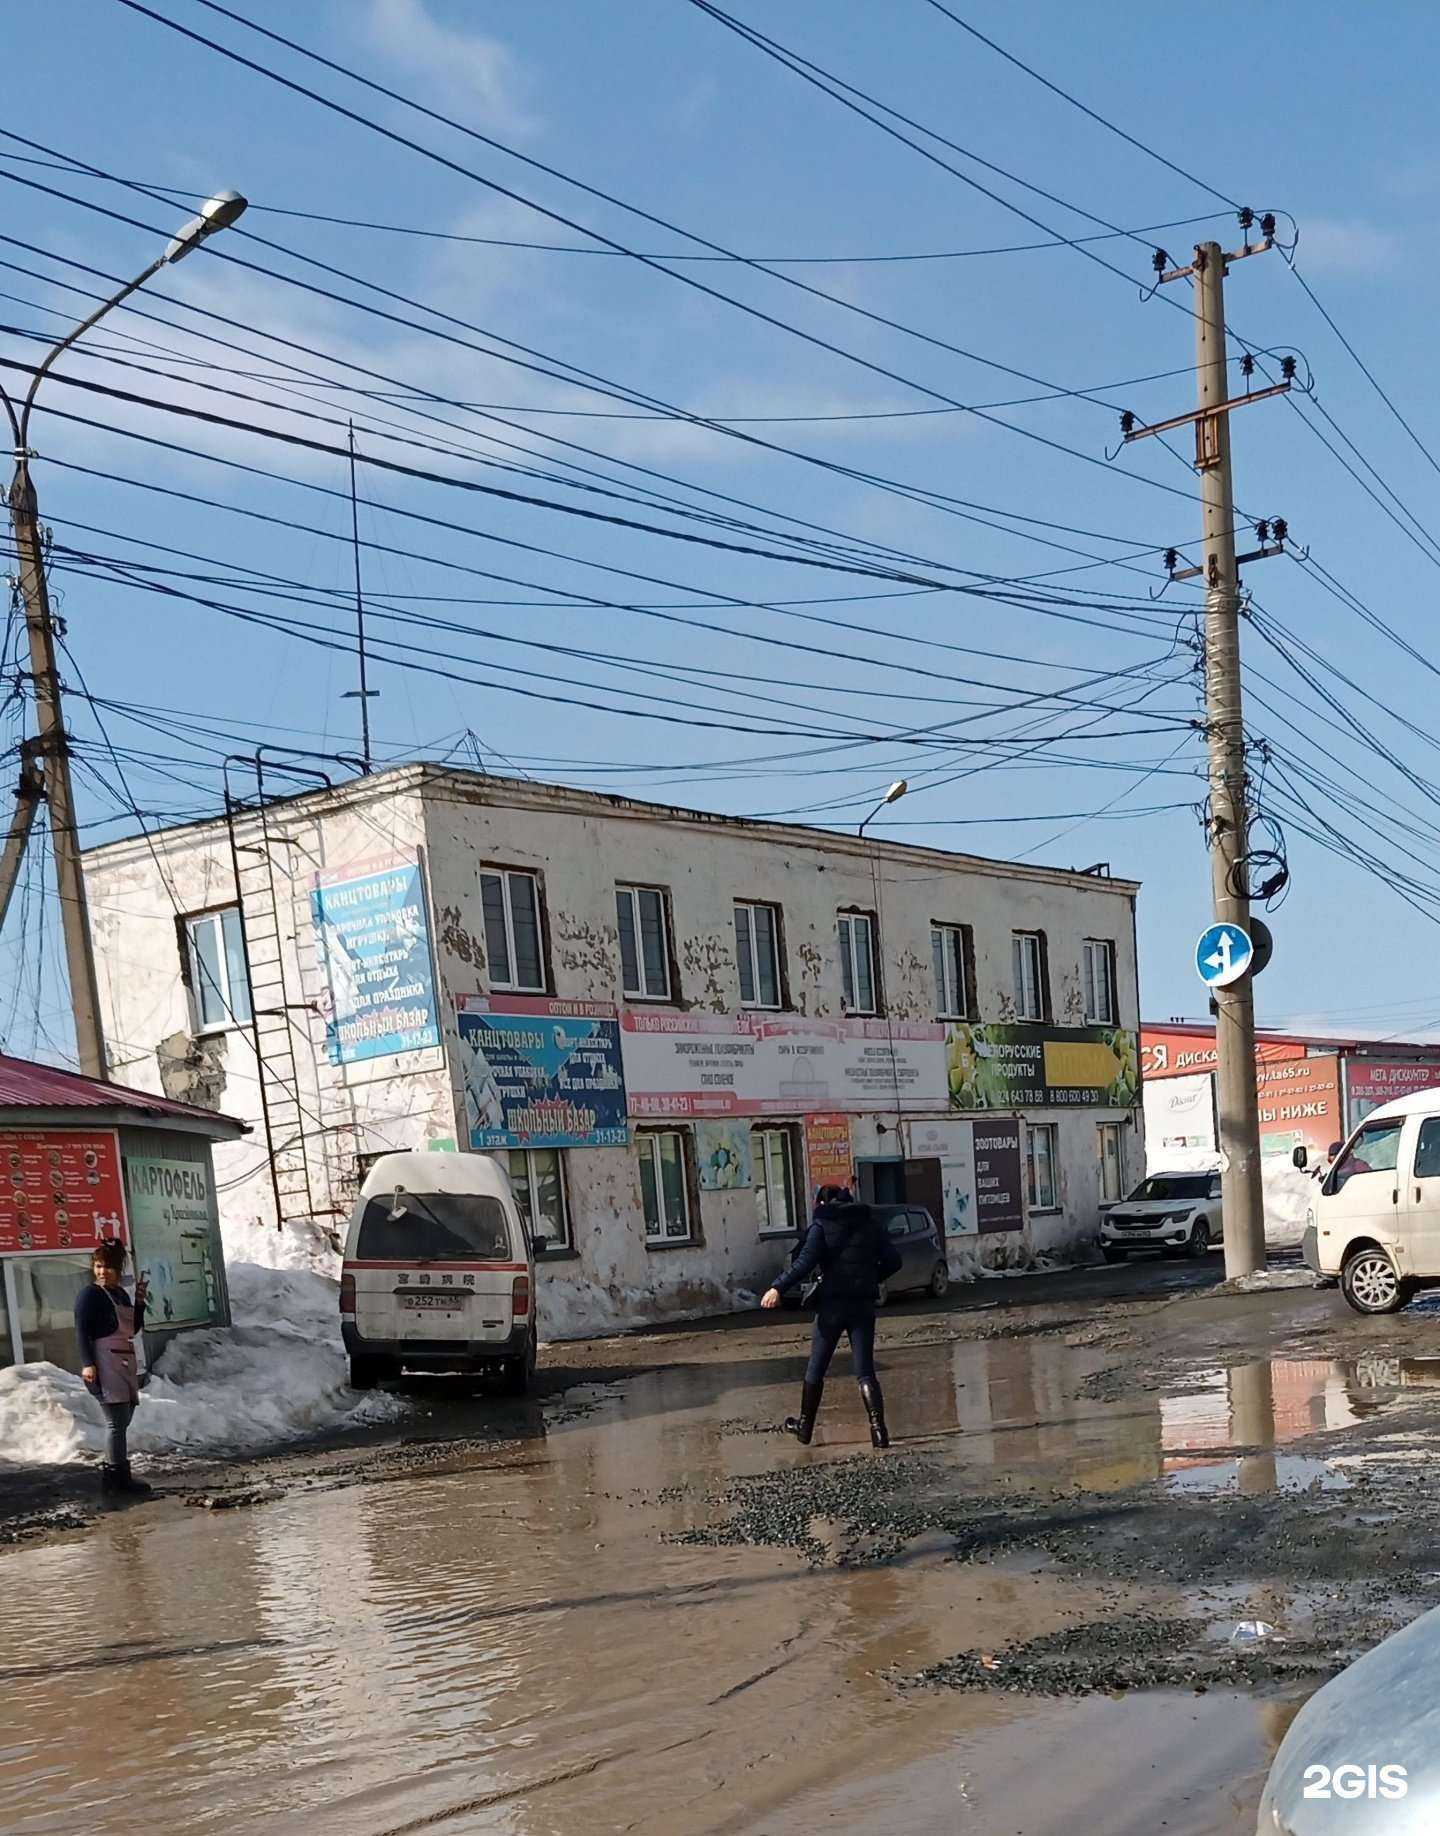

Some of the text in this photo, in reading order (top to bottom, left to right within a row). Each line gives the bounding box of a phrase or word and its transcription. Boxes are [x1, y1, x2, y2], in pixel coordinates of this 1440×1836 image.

[325, 876, 408, 911] КАНЦТОВАРЫ
[396, 1008, 429, 1031] БАЗАР
[468, 1028, 545, 1050] КАНЦТОВАРЫ
[1141, 1044, 1217, 1071] СЯ ДИСКА
[992, 1063, 1035, 1078] ПРОДУКТЫ
[507, 1109, 596, 1132] ШКОЛЬНЫЙ БАЗАР
[1280, 1100, 1328, 1120] НИЖЕ
[487, 1135, 507, 1146] этаж
[130, 1164, 205, 1200] КАРТОФЕЛЬ
